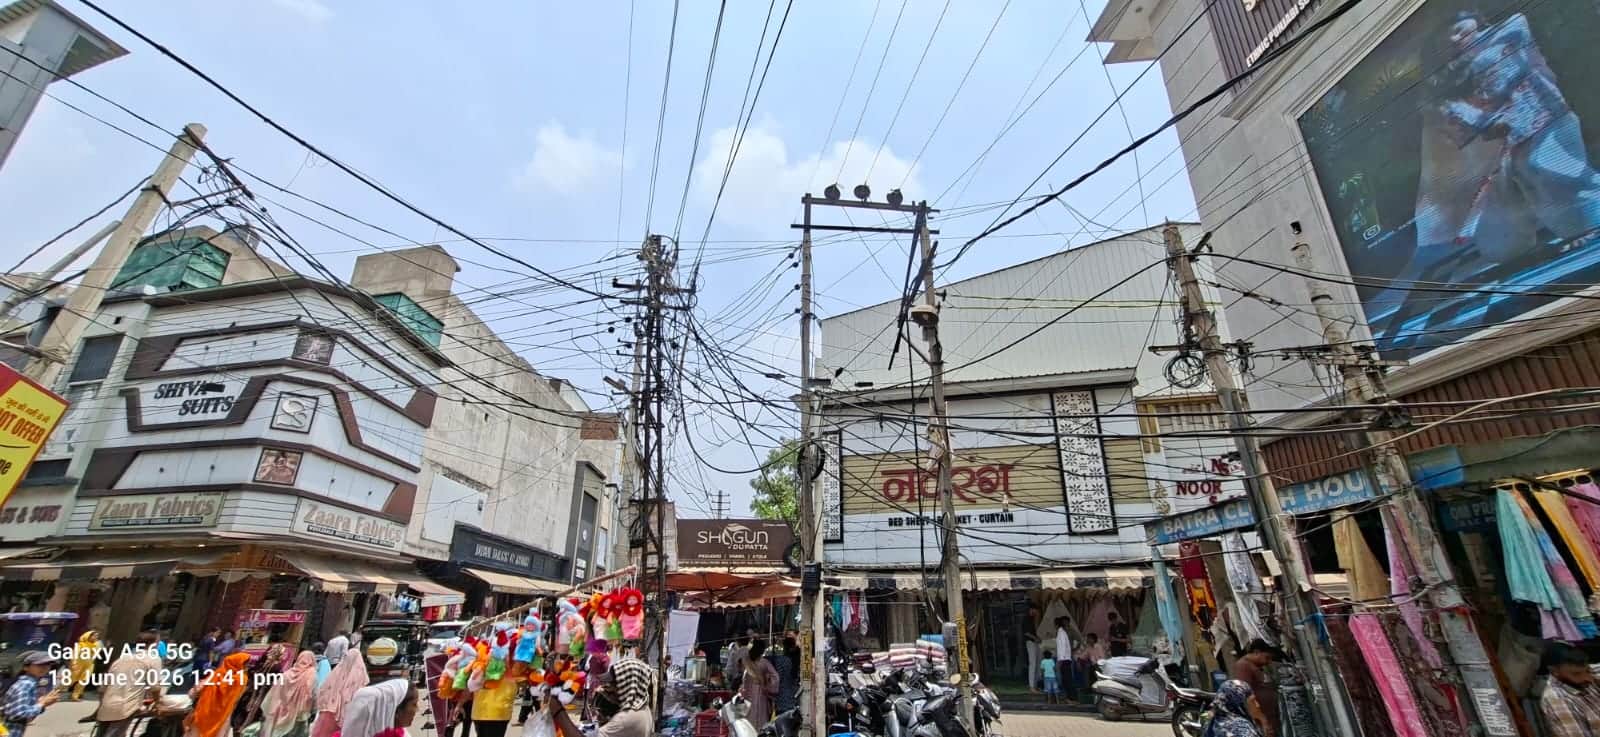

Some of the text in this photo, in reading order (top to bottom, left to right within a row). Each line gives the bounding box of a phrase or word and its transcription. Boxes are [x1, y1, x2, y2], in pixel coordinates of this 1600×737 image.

[154, 380, 208, 400] SHIVA
[178, 396, 235, 416] SUITS
[11, 418, 47, 446] OFFER
[1176, 481, 1223, 496] NOOR
[99, 495, 216, 519] Zaara Fabrics
[303, 503, 353, 530] Zaara
[355, 515, 402, 542] Fabrics
[979, 512, 1014, 524] CURTAIN
[1164, 512, 1217, 535] BATRA
